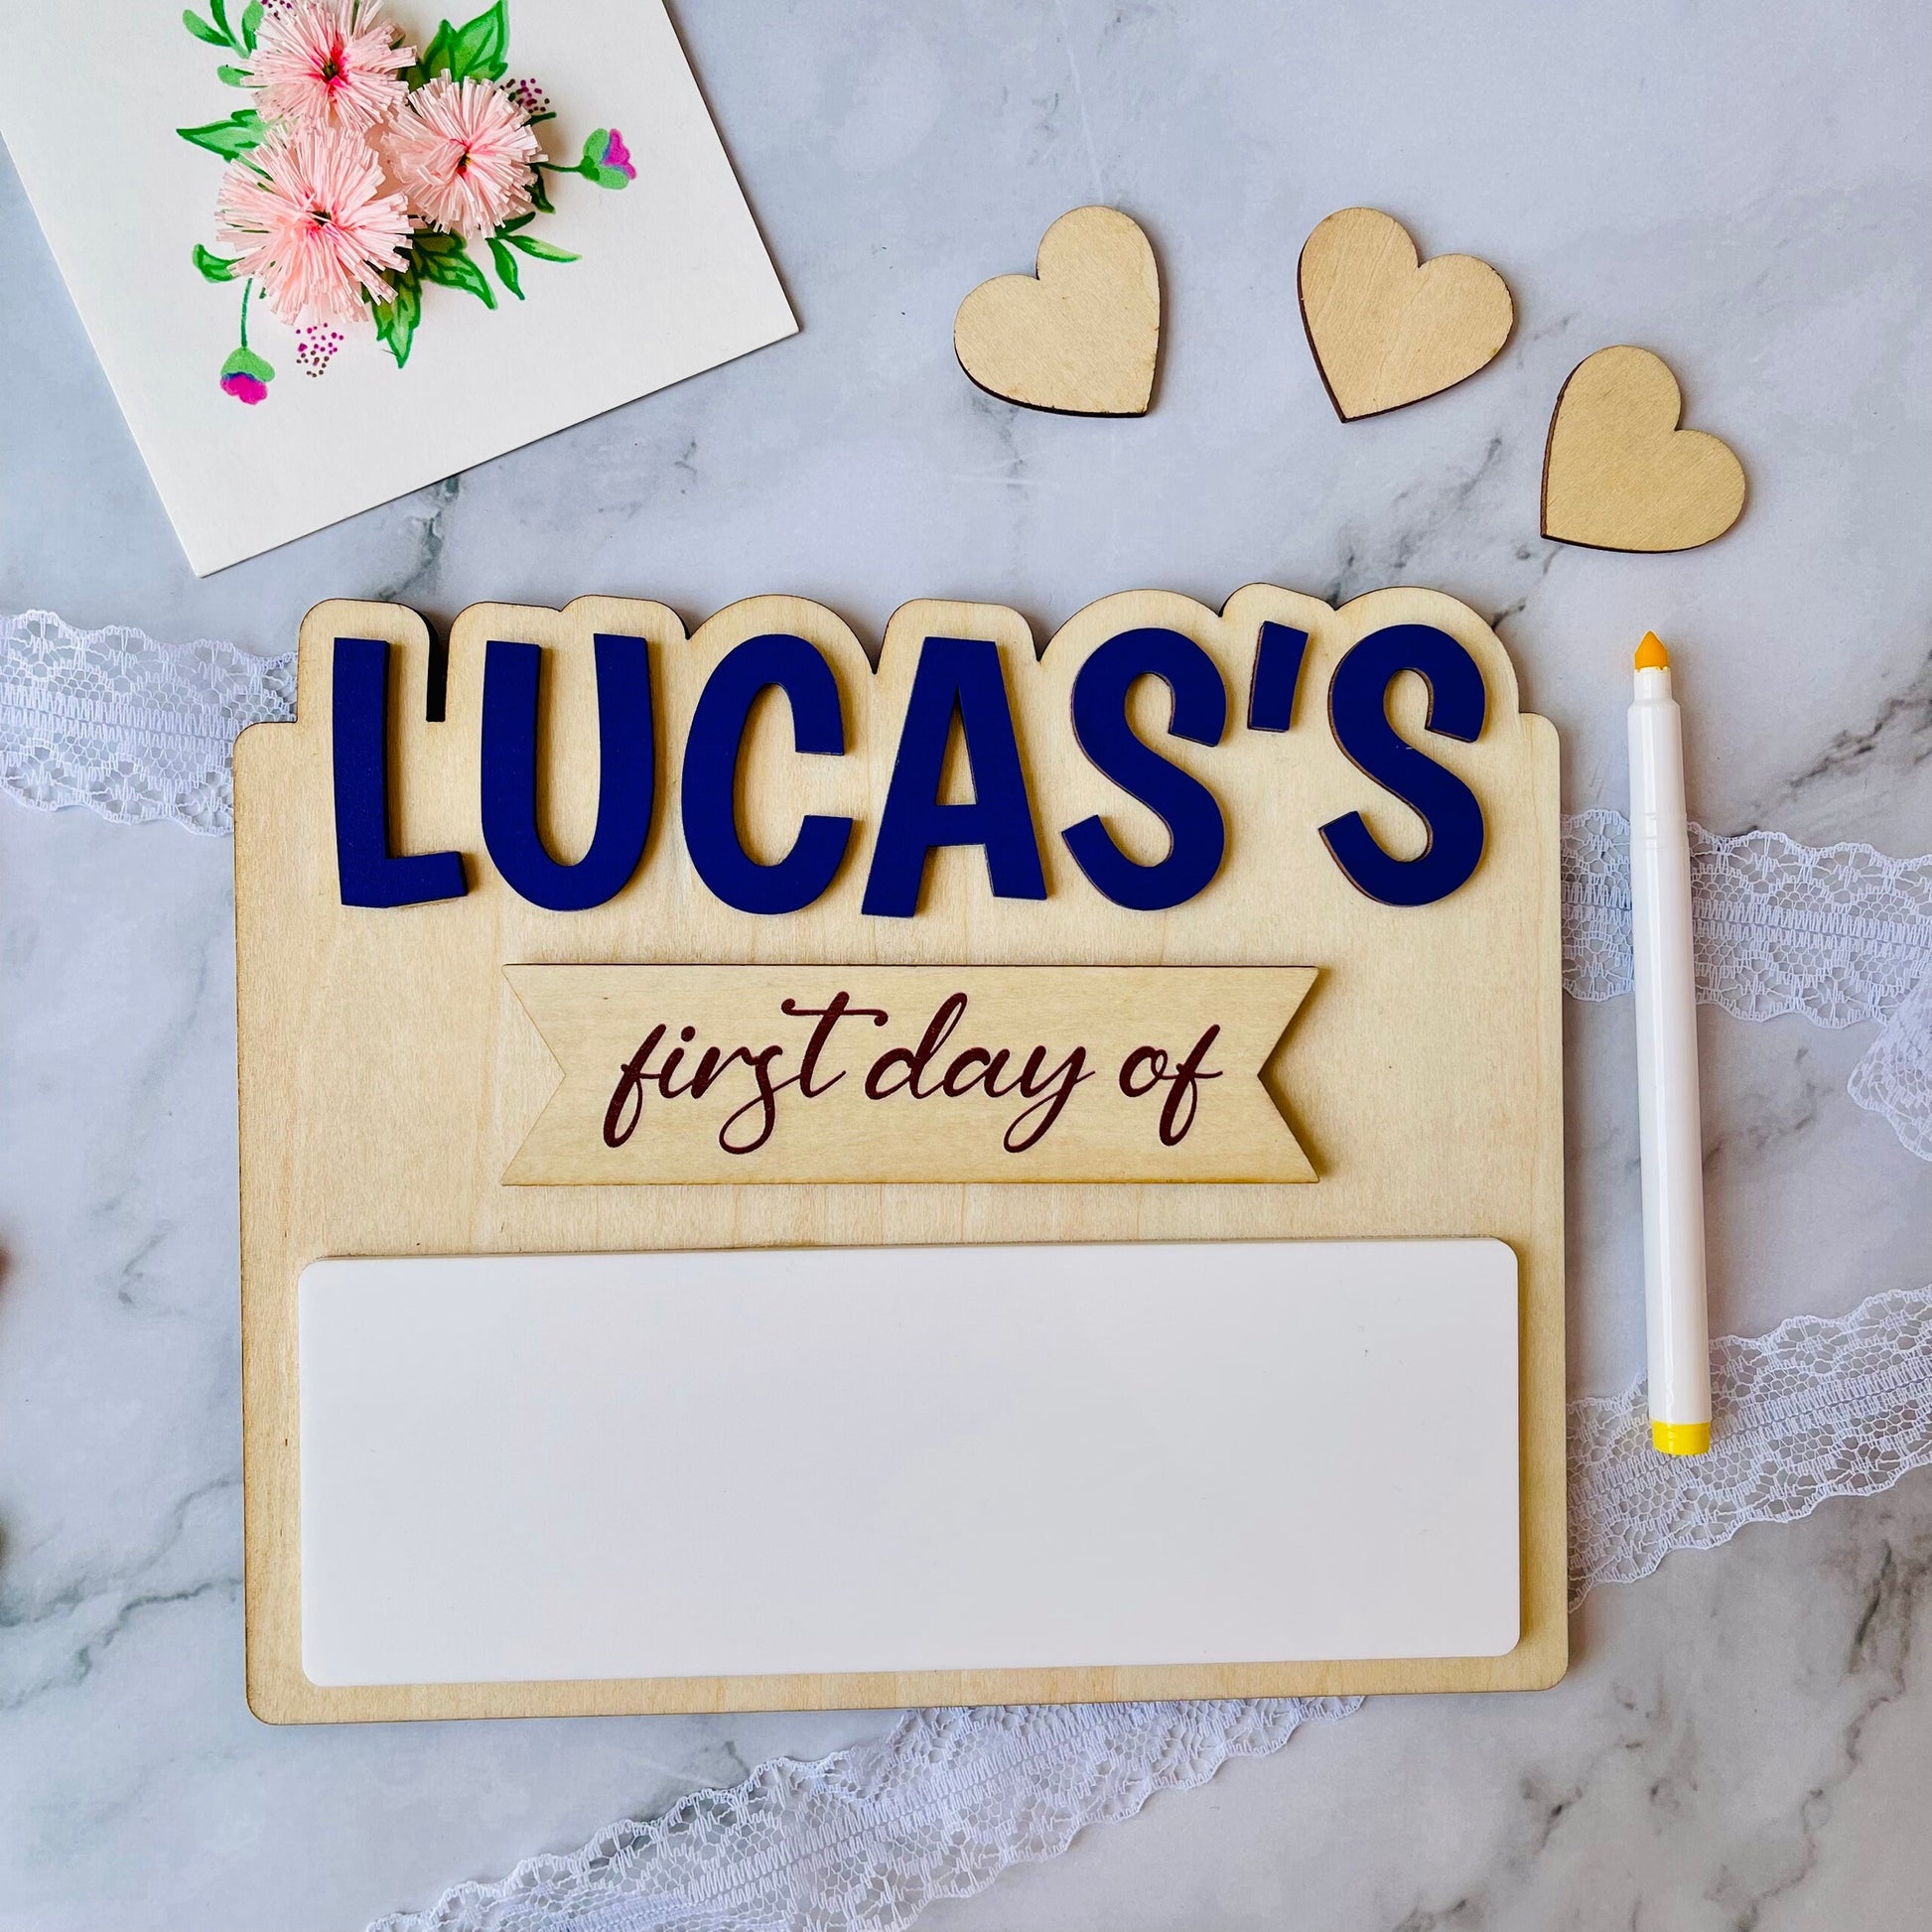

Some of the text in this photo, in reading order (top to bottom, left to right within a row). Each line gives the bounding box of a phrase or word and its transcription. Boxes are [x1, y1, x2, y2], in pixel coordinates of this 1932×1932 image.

[333, 621, 1486, 917] LUCAS'S
[603, 991, 1224, 1156] first day of
